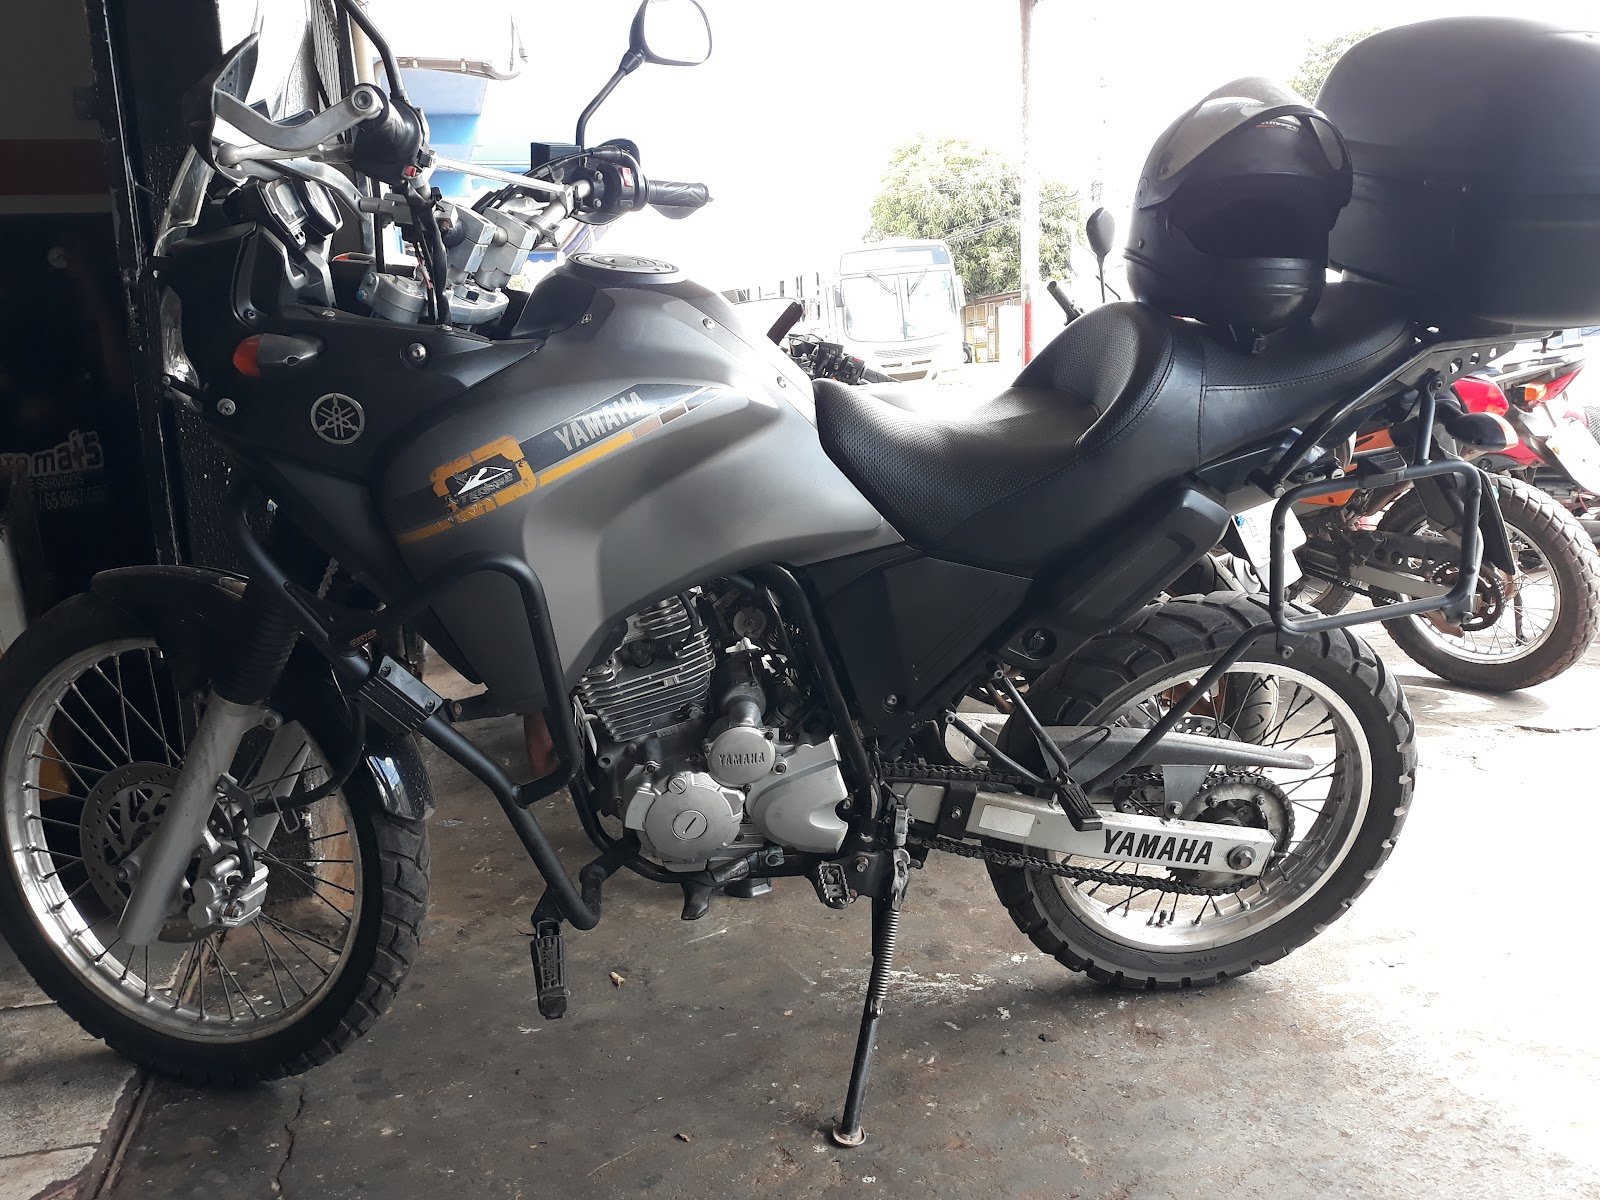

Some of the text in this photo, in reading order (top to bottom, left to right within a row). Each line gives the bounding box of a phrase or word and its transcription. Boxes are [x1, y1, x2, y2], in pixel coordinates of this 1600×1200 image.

[553, 391, 646, 451] YAMAHA
[719, 752, 765, 766] YAMAHA
[1103, 828, 1213, 865] YAMAHA
